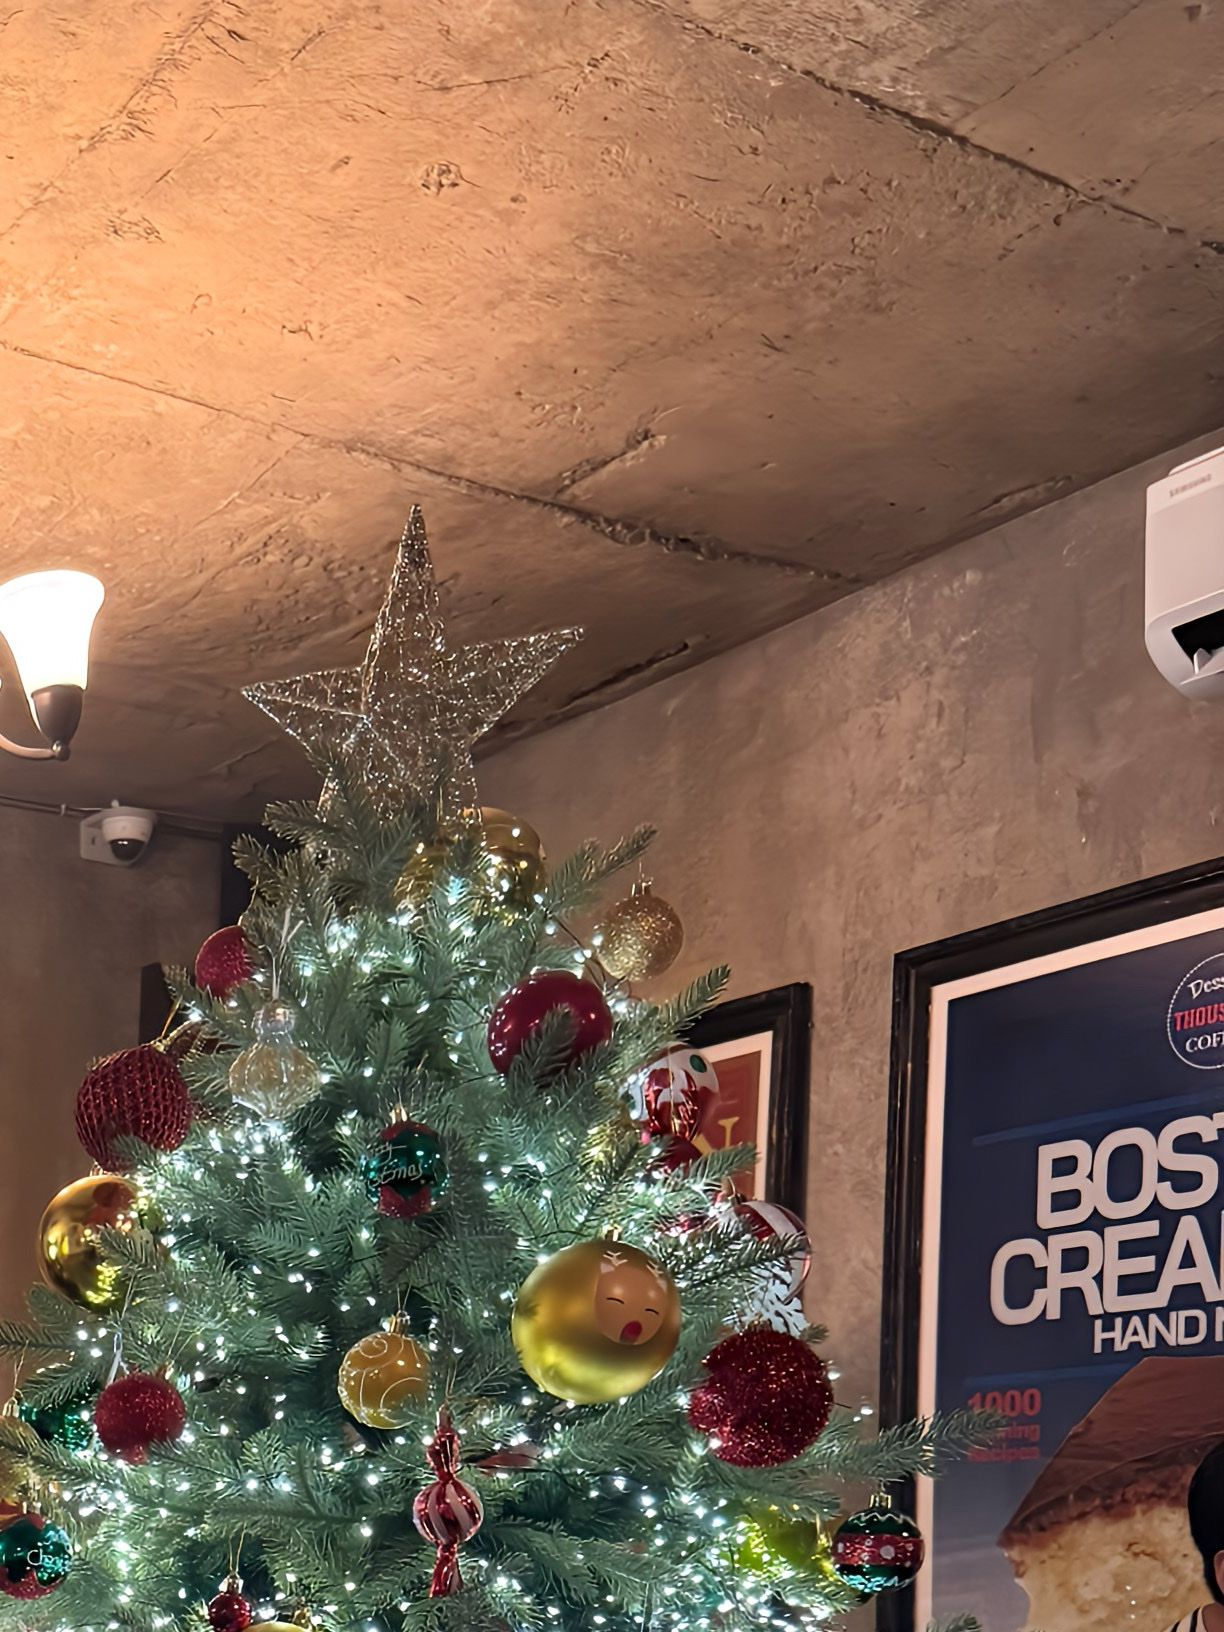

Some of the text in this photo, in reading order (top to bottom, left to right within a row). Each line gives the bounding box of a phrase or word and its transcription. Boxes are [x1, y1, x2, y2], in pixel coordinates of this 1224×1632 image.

[990, 1210, 1224, 1326] CREA
[1094, 1309, 1208, 1353] HAND
[967, 1388, 1041, 1417] 1000
